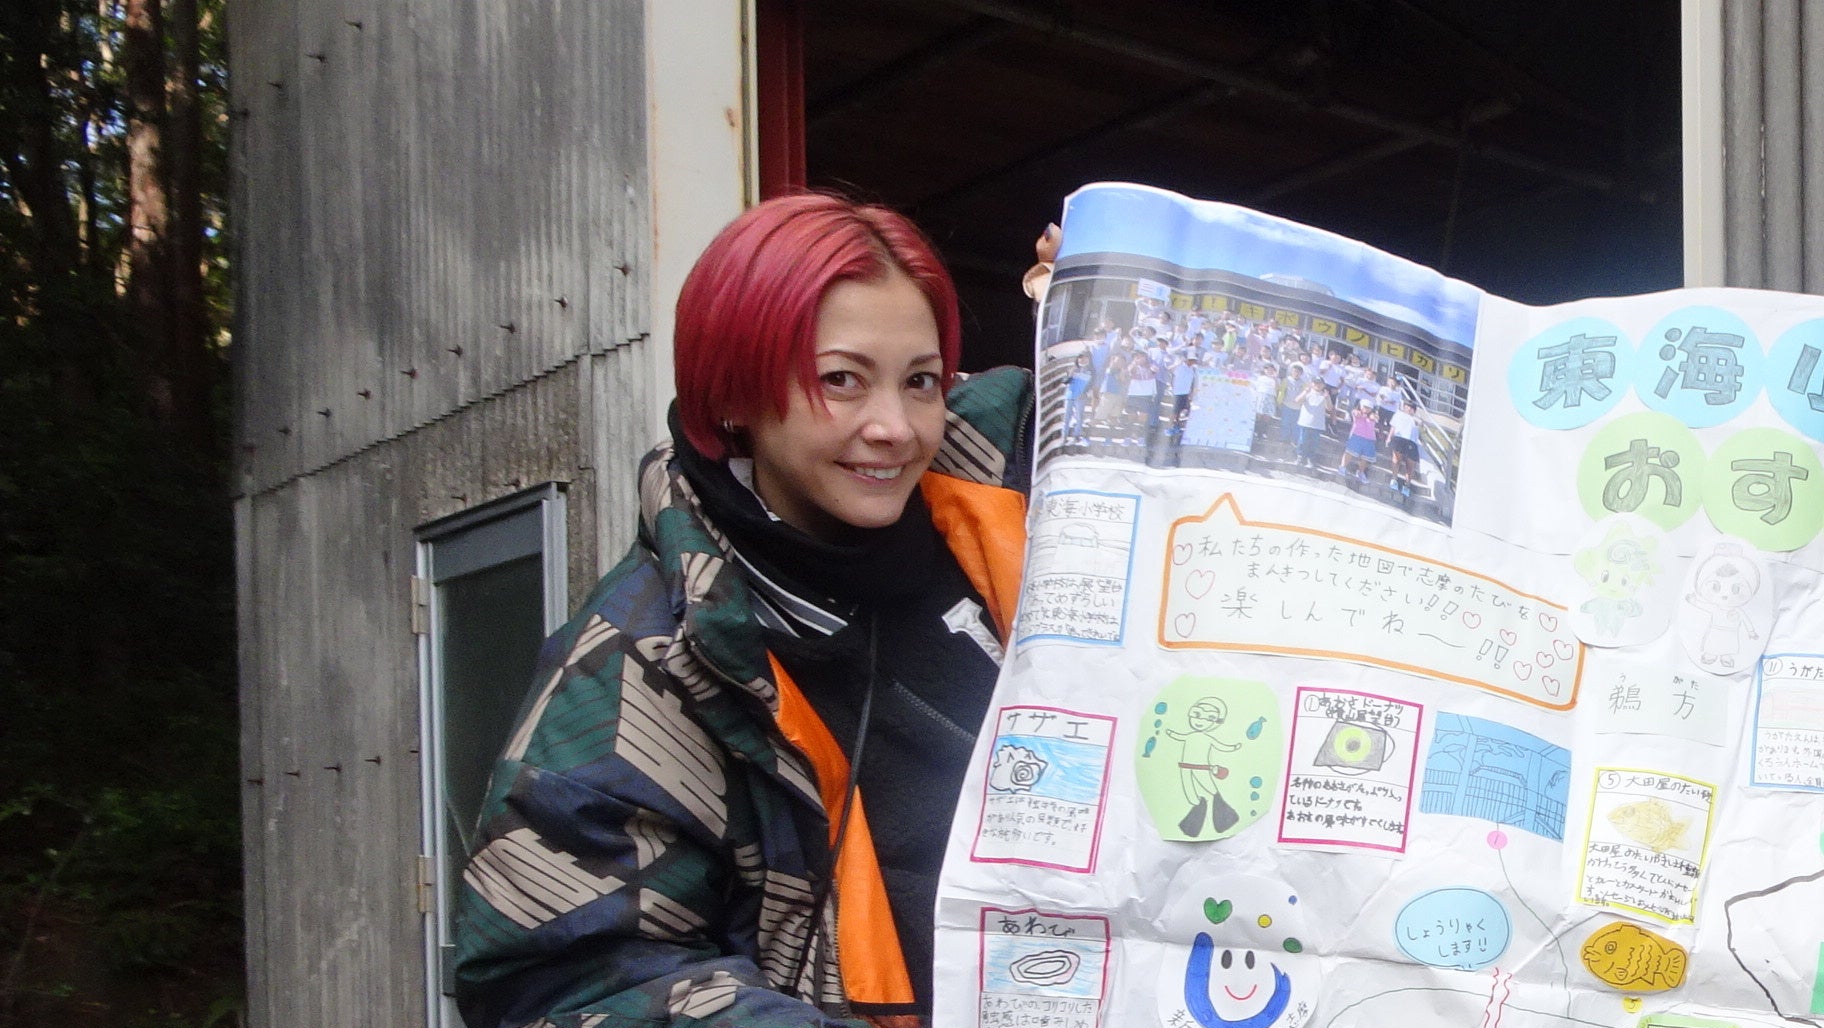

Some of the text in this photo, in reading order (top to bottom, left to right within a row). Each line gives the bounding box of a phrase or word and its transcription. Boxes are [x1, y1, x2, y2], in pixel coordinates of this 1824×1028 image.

[1607, 683, 1697, 721] 鵜方
[1006, 712, 1090, 741] サザエ
[998, 917, 1076, 937] あわび
